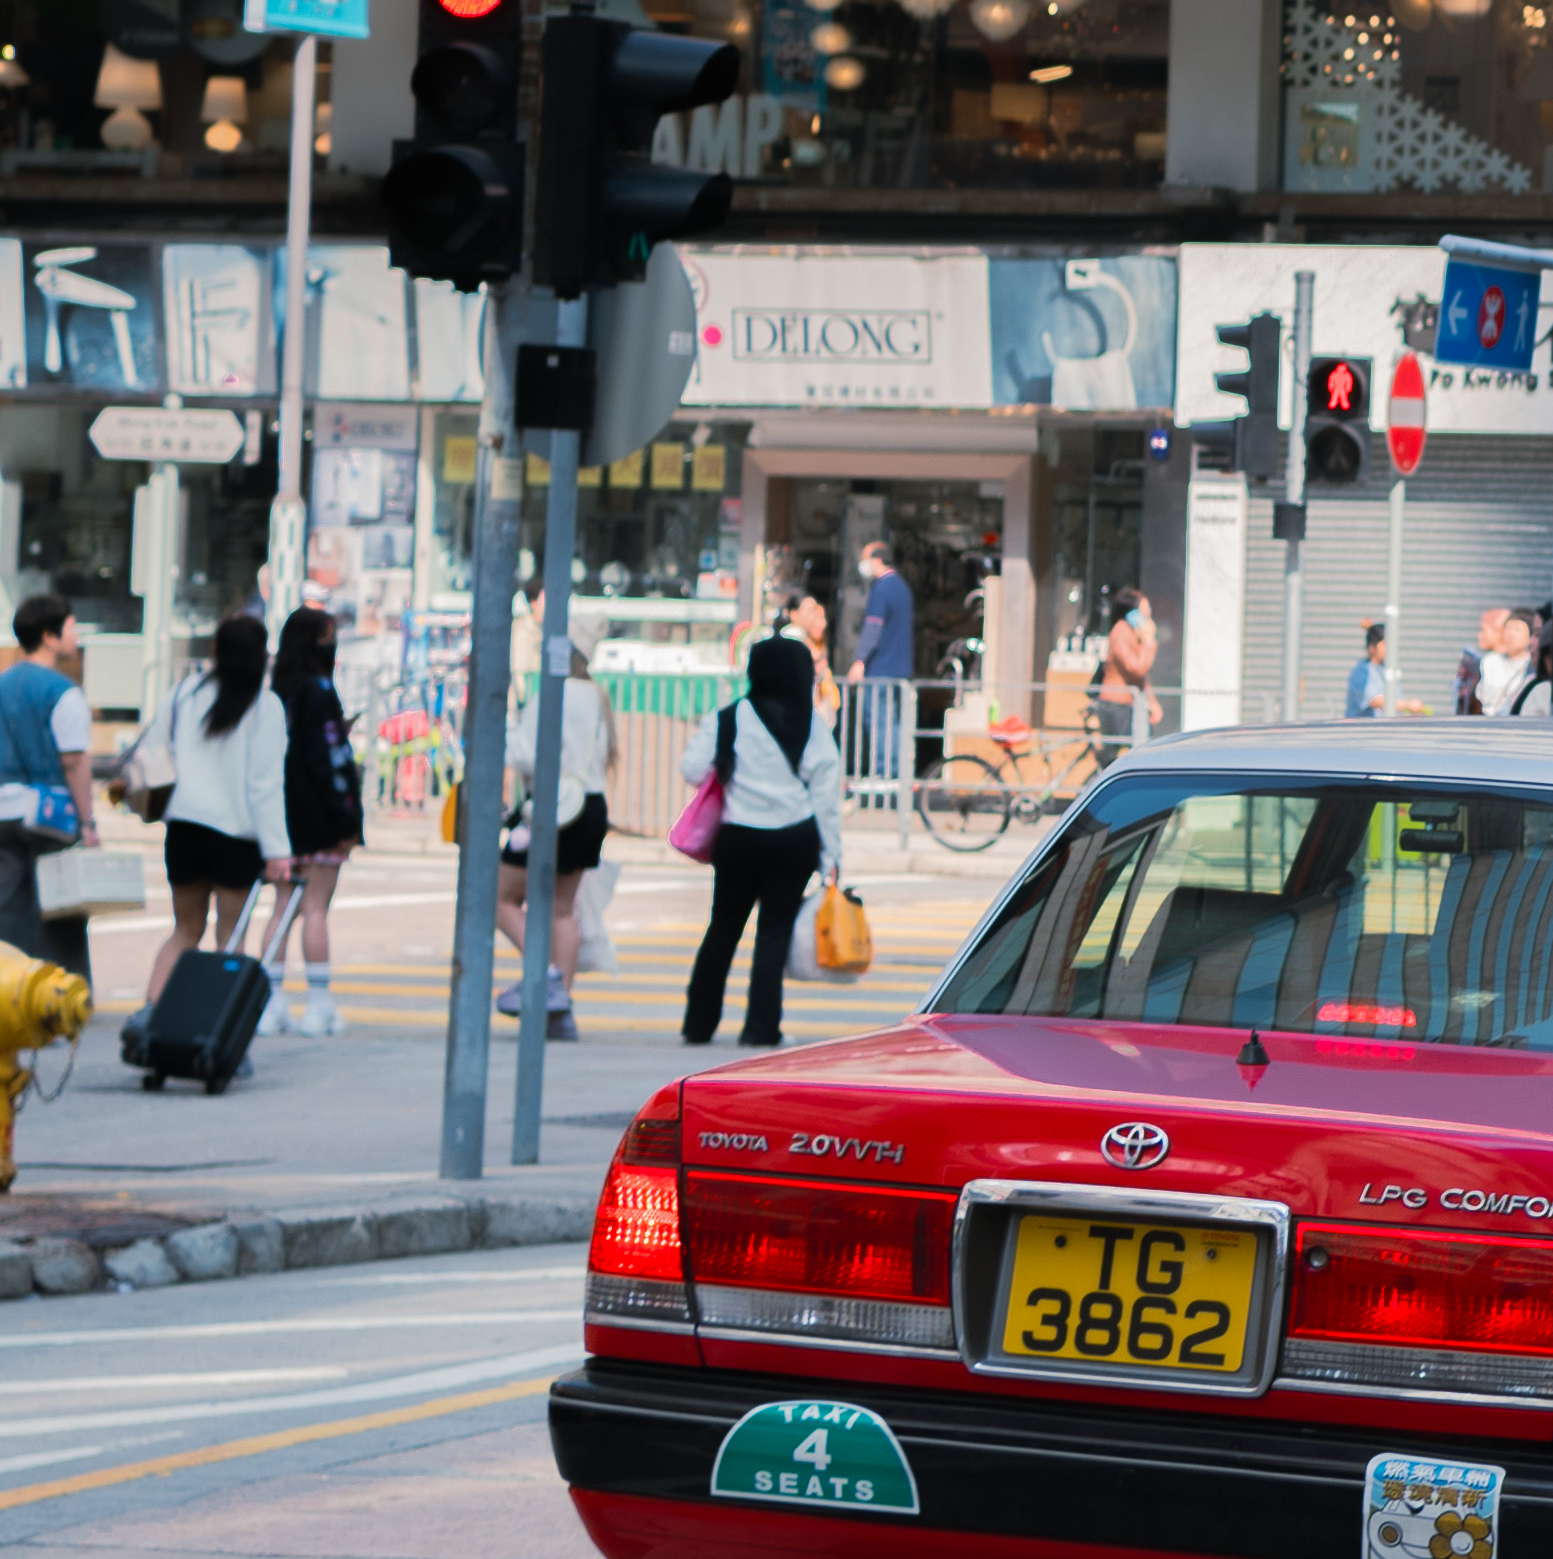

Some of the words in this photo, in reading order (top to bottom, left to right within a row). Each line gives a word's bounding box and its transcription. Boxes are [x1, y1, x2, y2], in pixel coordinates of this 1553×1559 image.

[1464, 369, 1538, 392] Kwong
[698, 1131, 768, 1153] TOYOTA
[1358, 1182, 1428, 1210] LPG
[1088, 1225, 1187, 1296] TG
[1021, 1286, 1231, 1367] 3862
[778, 1404, 862, 1430] TAXI
[792, 1427, 832, 1472] 4
[754, 1470, 875, 1502] SEATS
